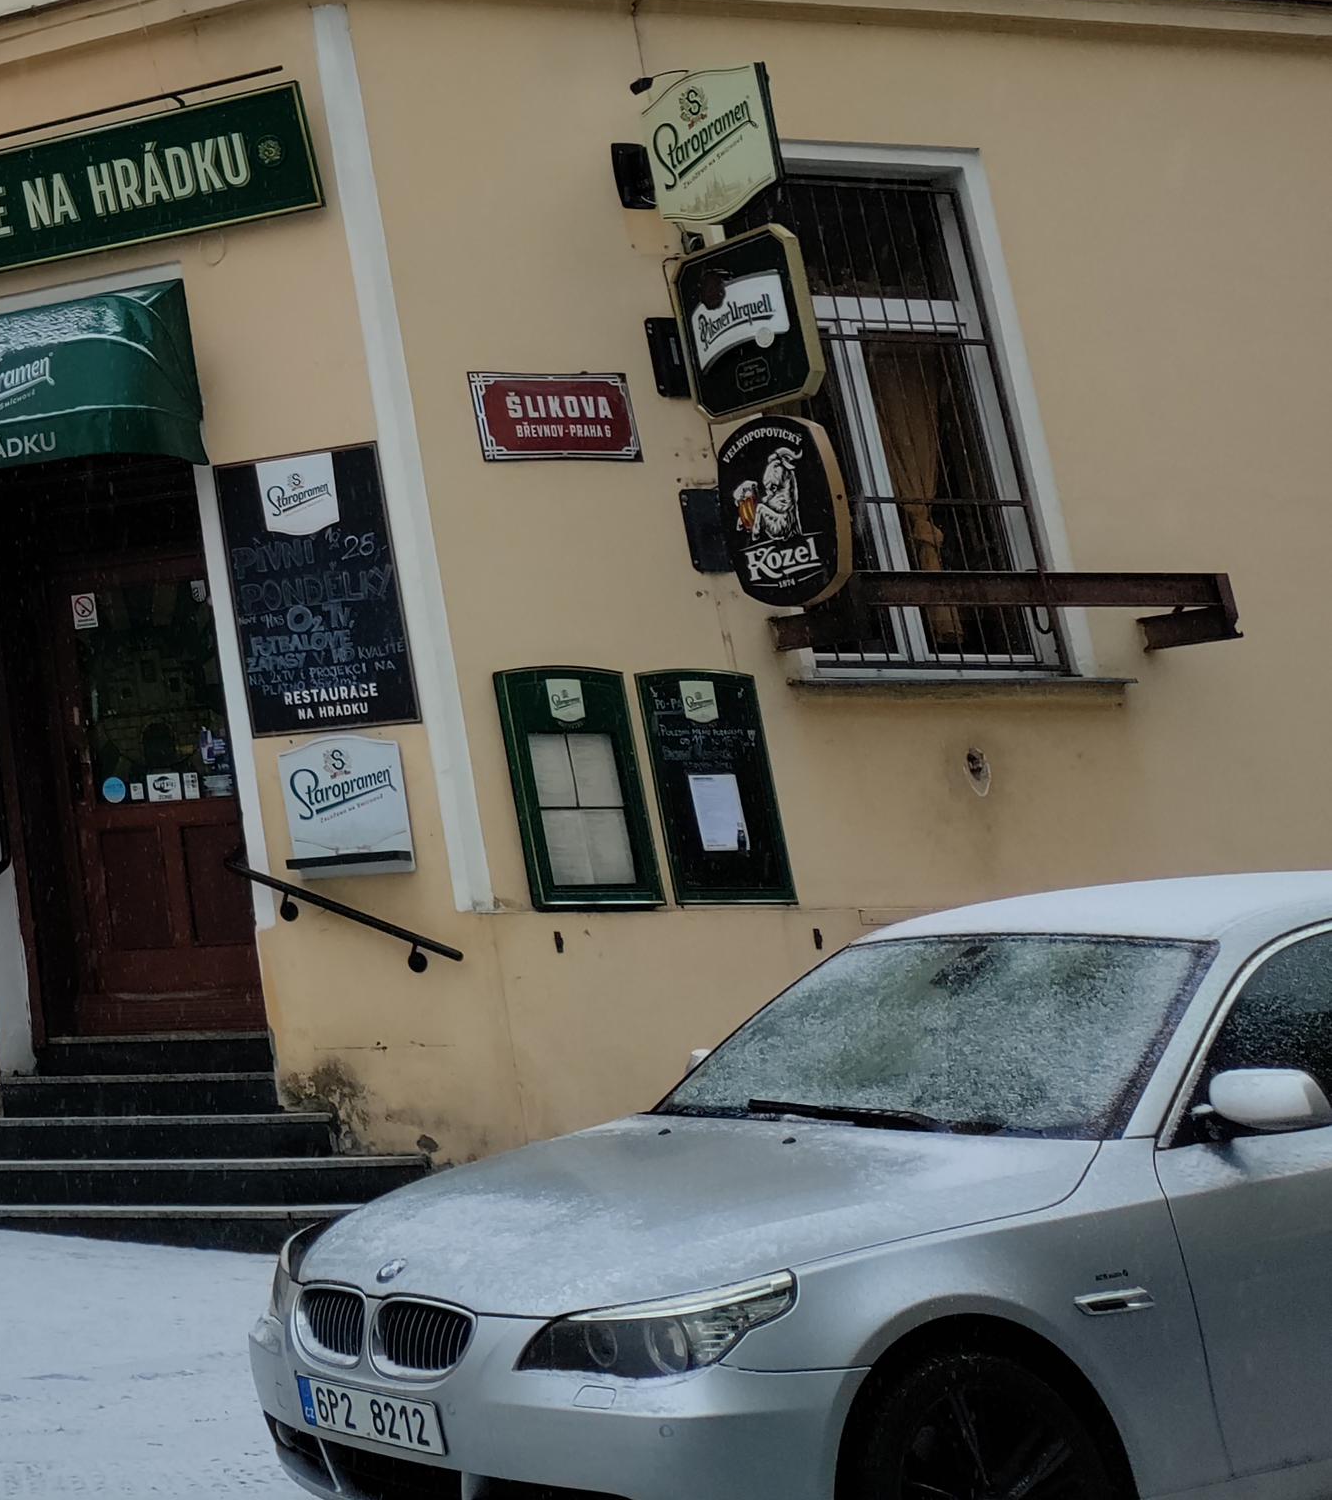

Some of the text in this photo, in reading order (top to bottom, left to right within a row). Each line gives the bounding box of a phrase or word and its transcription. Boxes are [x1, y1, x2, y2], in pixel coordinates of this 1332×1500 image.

[653, 100, 758, 191] Staropramen
[22, 174, 81, 231] NA
[86, 132, 252, 218] HRÁDKU
[698, 293, 773, 352] Pilsner Urquell
[505, 392, 613, 419] ŠLIKOVA
[605, 425, 612, 438] 6
[722, 427, 803, 464] VELKOPOPOVICKÝ
[267, 483, 332, 517] Staropramen
[745, 537, 821, 581] Kozel
[778, 578, 796, 589] 1874
[375, 660, 397, 672] NA
[284, 683, 378, 706] RESTAURACE
[298, 701, 369, 720] NA HRÁDKU
[290, 768, 397, 820] Staropramen
[315, 1387, 357, 1430] 6P2
[370, 1399, 430, 1447] 8212
